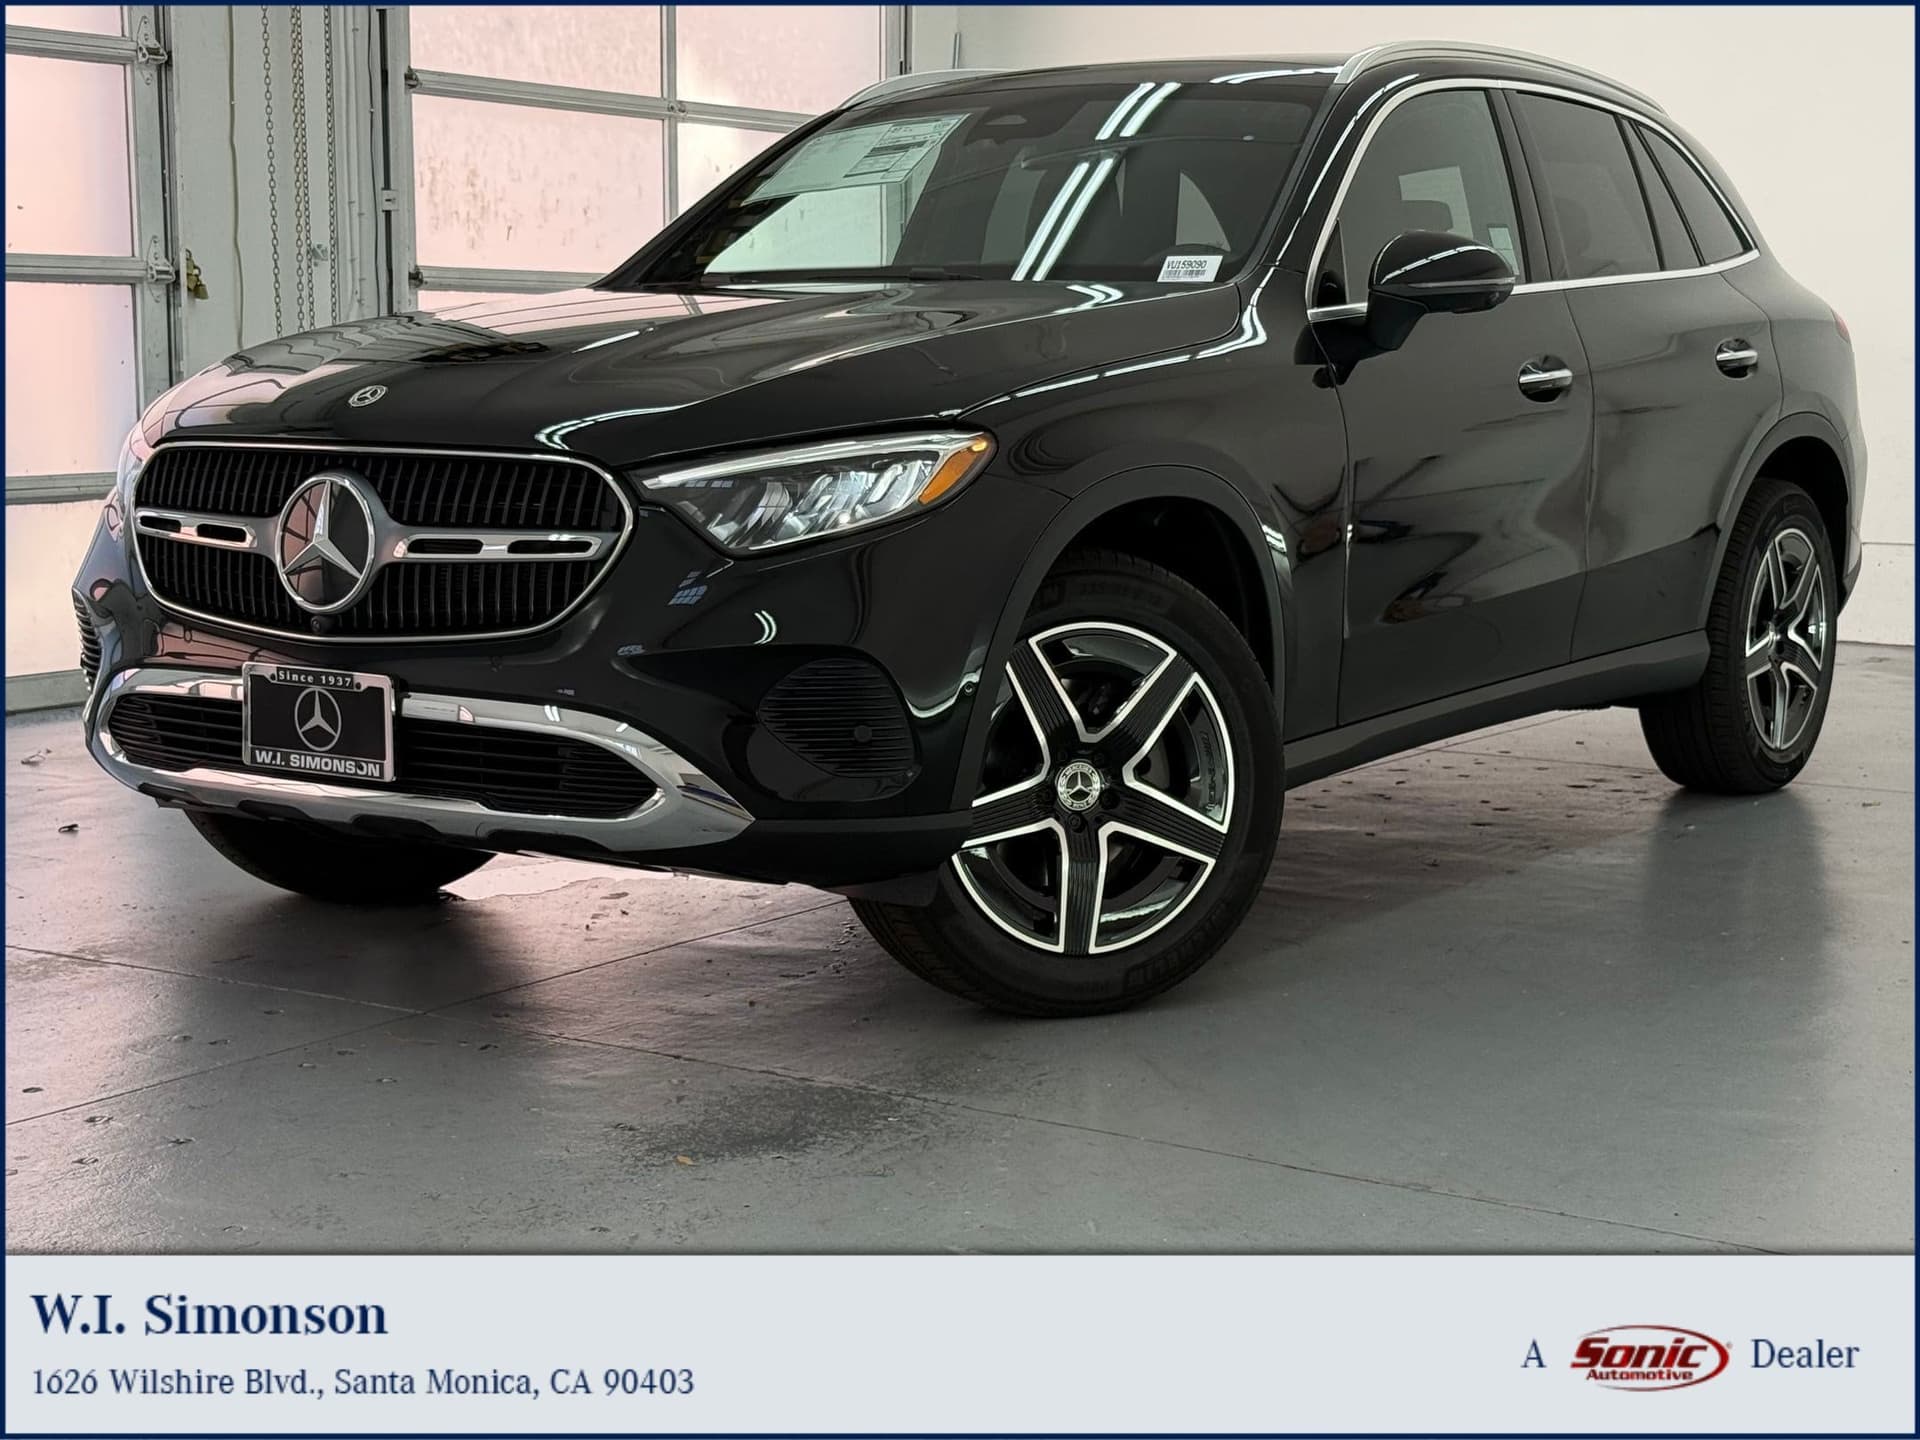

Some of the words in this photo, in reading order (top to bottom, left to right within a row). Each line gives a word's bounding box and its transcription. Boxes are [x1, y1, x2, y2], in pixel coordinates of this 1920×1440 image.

[278, 671, 314, 683] Since
[320, 675, 351, 686] 1937
[255, 750, 285, 765] W.I.
[290, 754, 380, 777] SIMONSON
